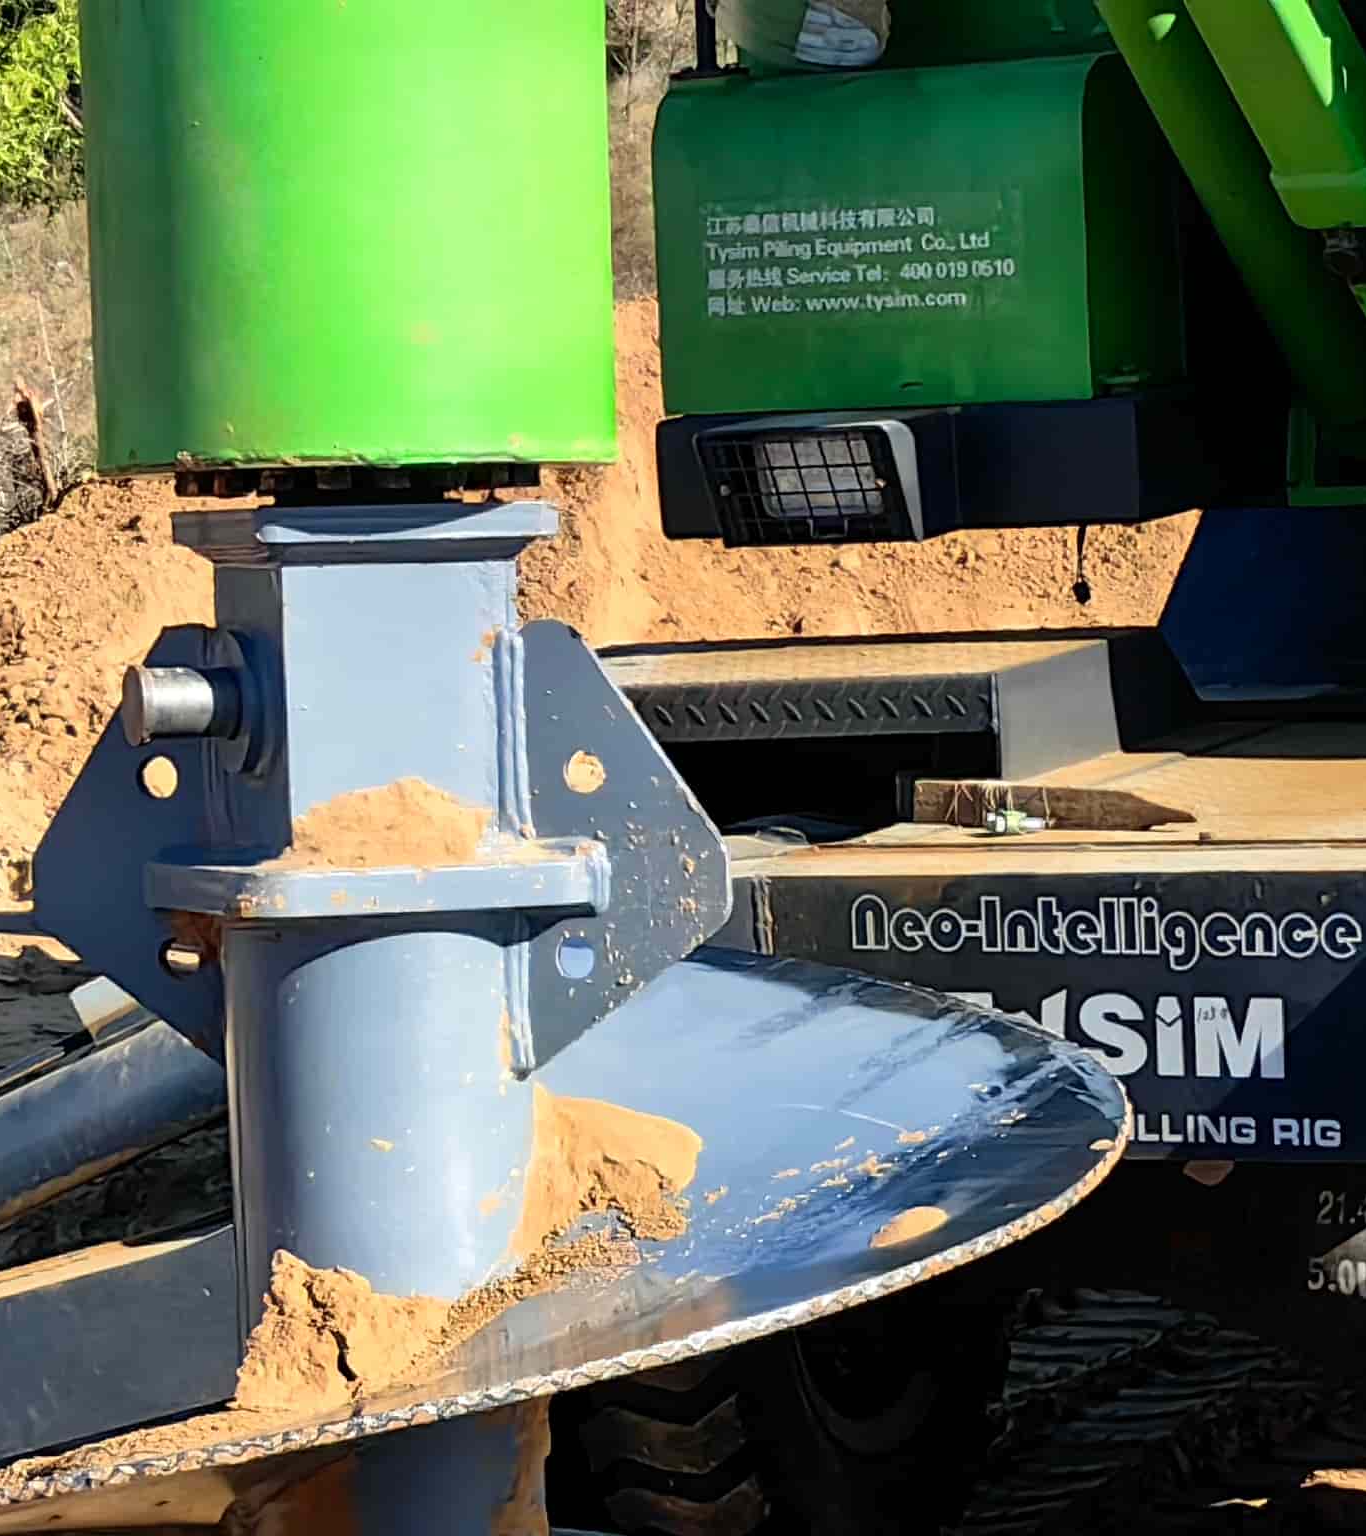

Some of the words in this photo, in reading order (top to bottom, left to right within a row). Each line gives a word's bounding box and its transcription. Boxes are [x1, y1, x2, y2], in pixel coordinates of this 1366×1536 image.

[705, 242, 760, 264] Tysim
[815, 236, 912, 259] Equipment
[959, 231, 990, 250] Ltd
[786, 265, 852, 285] Service
[900, 261, 932, 280] 400
[936, 260, 968, 278] 019
[972, 258, 1015, 277] 0510
[751, 295, 801, 313] Web:
[805, 290, 966, 312] www.tysim.com
[851, 893, 1363, 970] Neo-Intelligence
[1272, 1117, 1342, 1147] RIG
